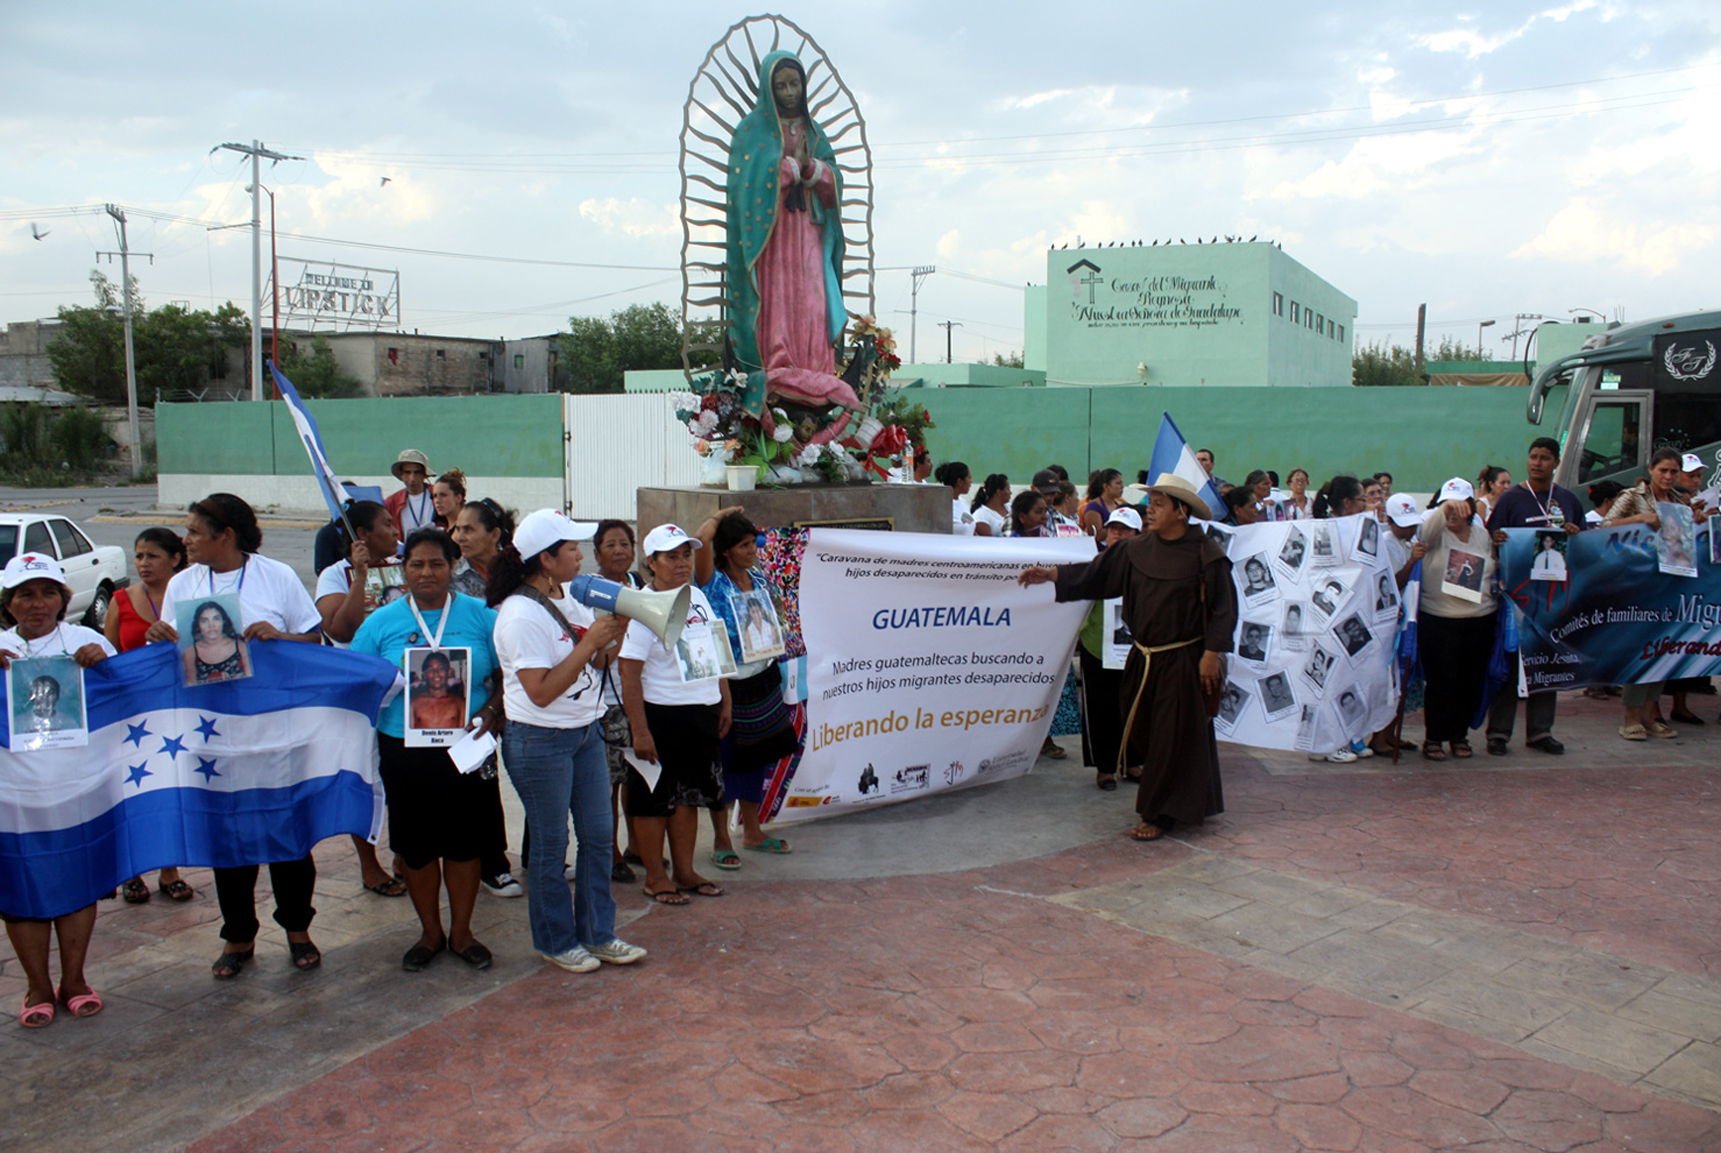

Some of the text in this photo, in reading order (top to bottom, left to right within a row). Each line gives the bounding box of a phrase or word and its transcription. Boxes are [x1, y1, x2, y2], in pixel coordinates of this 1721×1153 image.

[1111, 278, 1141, 292] Casa
[285, 287, 391, 316] LIPSTICK
[1138, 291, 1191, 308] Reynosa
[845, 567, 871, 579] hijos
[873, 568, 948, 580] desaparecidos
[965, 572, 1004, 581] tránsito
[873, 557, 888, 565] de
[889, 558, 929, 567] madres
[931, 560, 1020, 570] centroamericanas
[1021, 562, 1034, 570] en
[873, 606, 1012, 630] GUATEMALA
[1550, 612, 1589, 644] Comités
[1591, 609, 1605, 624] de
[1606, 605, 1660, 623] familiares
[1662, 606, 1673, 622] de
[833, 651, 1044, 676] Madres guatemaltecas buscando a
[822, 670, 1056, 701] nuestros hijos migrantes desaparecidos
[1533, 671, 1575, 686] Migrantes
[812, 703, 1050, 752] Liberando la esperanza
